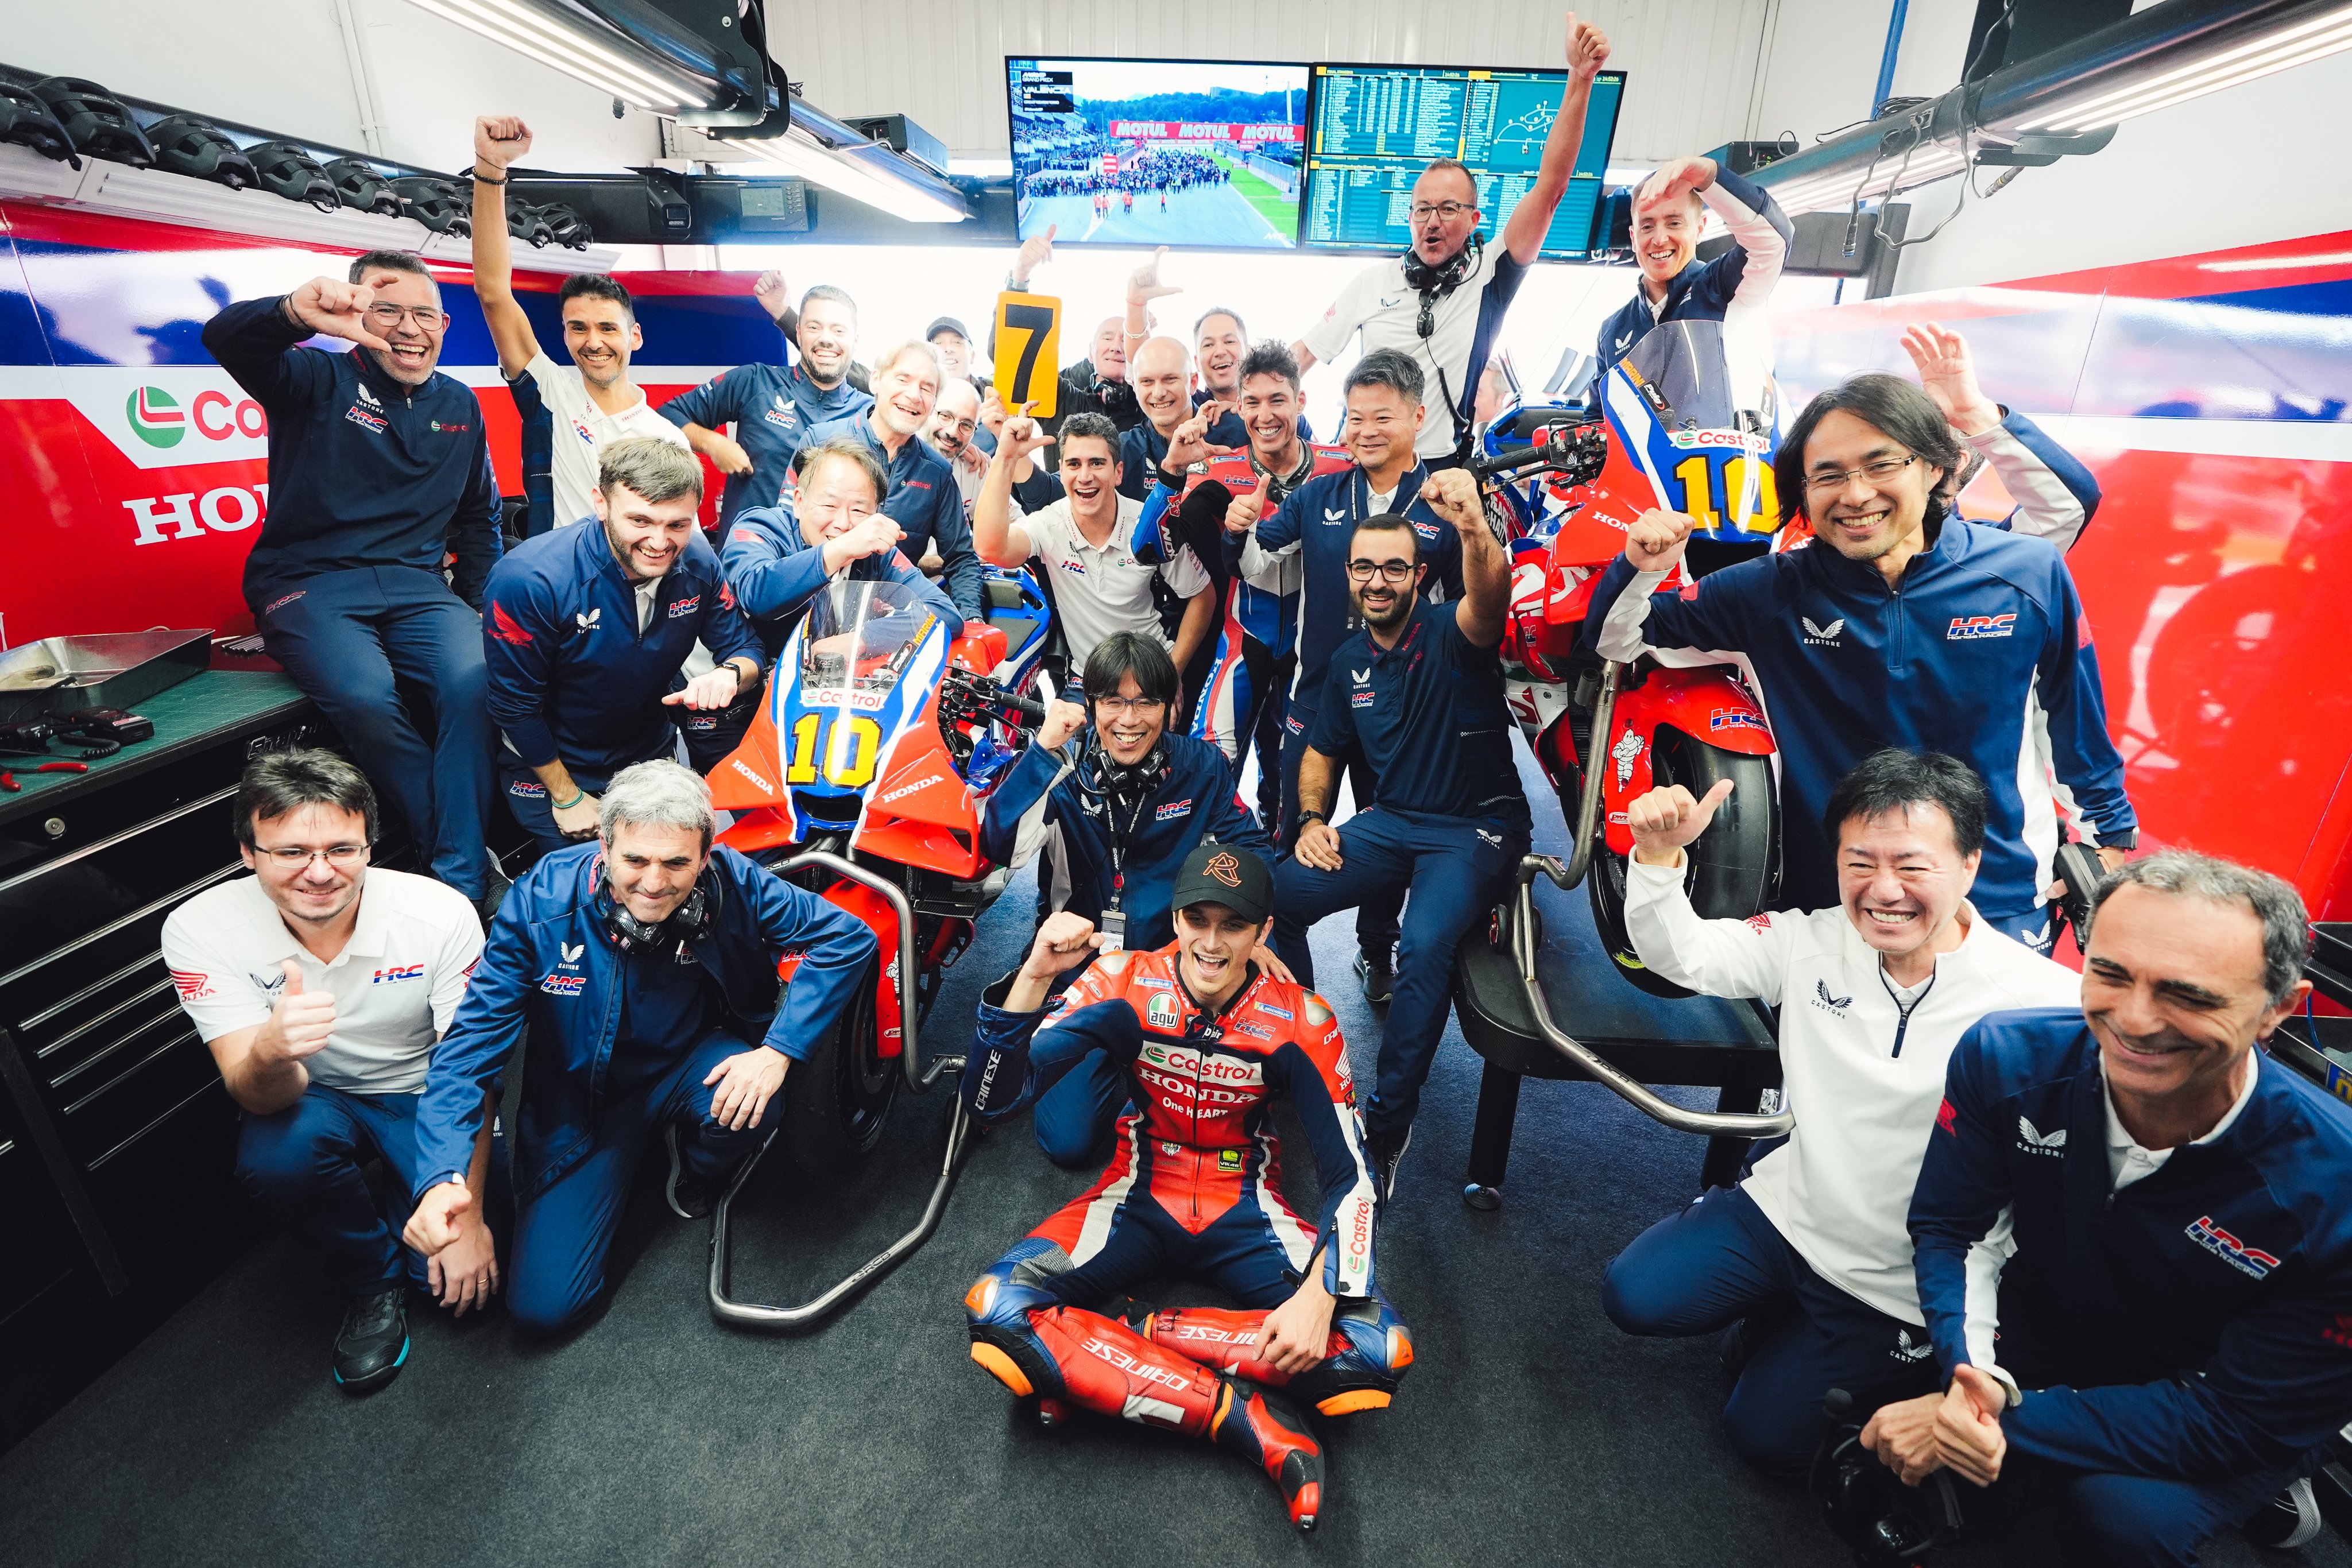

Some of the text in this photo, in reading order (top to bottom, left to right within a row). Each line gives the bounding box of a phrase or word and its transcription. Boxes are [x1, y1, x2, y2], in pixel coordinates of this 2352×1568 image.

[1116, 122, 1167, 137] MOTUL
[1178, 124, 1231, 138] MOTUL
[1241, 126, 1295, 140] MOTUL
[1005, 304, 1053, 404] 7
[1619, 358, 1646, 388] MARINI
[1643, 383, 1662, 405] Puig
[356, 399, 384, 414] CASTORE
[621, 409, 643, 422] HONDA
[346, 406, 388, 431] HRC
[765, 409, 796, 427] HRC
[906, 481, 932, 490] Castrol
[1224, 474, 1257, 486] HRC
[1673, 454, 1781, 536] 10
[1067, 516, 1078, 542] HONDA
[1117, 516, 1125, 542] HONDA
[1061, 560, 1085, 574] HRC
[668, 594, 701, 616] HRC
[912, 611, 938, 646] MARINI
[1947, 614, 2017, 636] HRC
[1401, 622, 1422, 652] HONDA
[1804, 638, 1840, 647] CASTORE
[819, 690, 881, 708] Catrol
[1190, 657, 1224, 735] HONDA
[1352, 692, 1375, 706] HRC
[687, 717, 717, 727] HRC
[1711, 722, 1746, 732] Honda
[786, 713, 883, 789] 10
[510, 780, 546, 795] HRC
[732, 758, 774, 796] HONDA
[882, 775, 945, 803] HONDA
[1156, 799, 1192, 819] HRC
[374, 964, 424, 984] HRC
[540, 974, 587, 992] HRC
[1144, 978, 1172, 988] MICHELIN
[1162, 955, 1190, 1009] HONDA
[540, 987, 563, 995] Honda
[1229, 977, 1269, 1020] DAINESE
[1150, 1012, 1177, 1027] agv
[1263, 1005, 1291, 1019] MICHELIN
[1811, 999, 1846, 1020] CASTORE
[1236, 1017, 1276, 1038] HRC
[1168, 1053, 1255, 1080] Castrol
[974, 1048, 1001, 1111] DAINESE
[1139, 1067, 1259, 1104] HONDA
[1162, 1097, 1228, 1120] One HEART
[1350, 1197, 1370, 1256] Castrol
[2185, 1215, 2281, 1276] HRC
[1081, 1337, 1190, 1392] DAINESE
